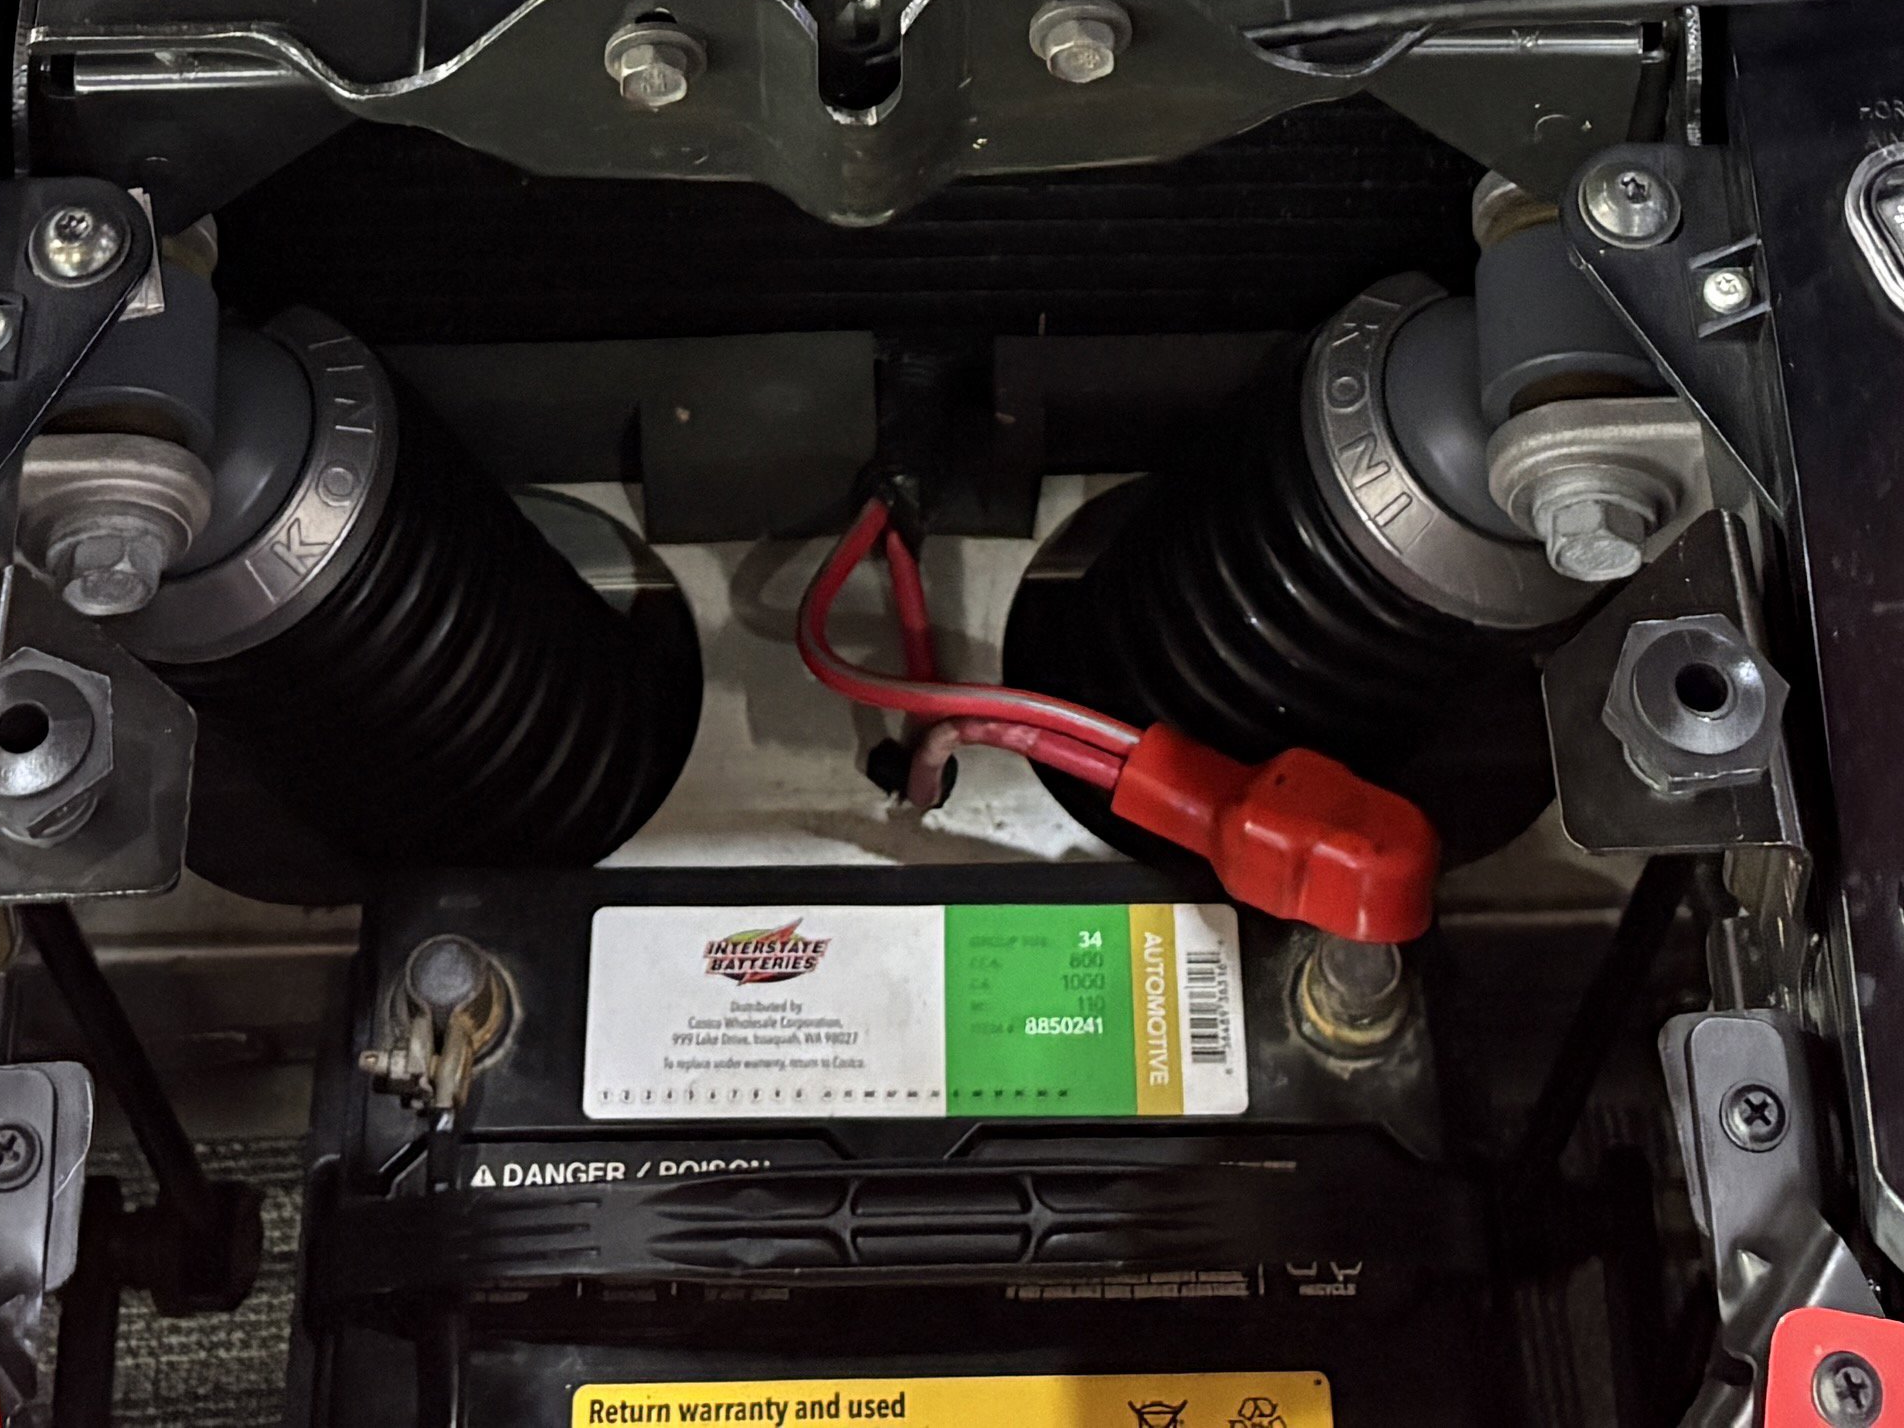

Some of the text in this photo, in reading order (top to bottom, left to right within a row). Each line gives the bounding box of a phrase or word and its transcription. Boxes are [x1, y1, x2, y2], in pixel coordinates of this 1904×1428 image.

[1326, 314, 1418, 529] KONI
[269, 360, 377, 578] KONI
[706, 940, 827, 955] INTERSTATE
[1077, 930, 1103, 949] 34
[709, 955, 819, 971] BATTERIES
[1062, 973, 1105, 991] 1000
[1143, 931, 1171, 1087] AUTOMOTIVE
[1024, 1016, 1104, 1035] 8850241
[502, 1161, 627, 1187] DANGER
[588, 1390, 906, 1428] Return warranty and used
